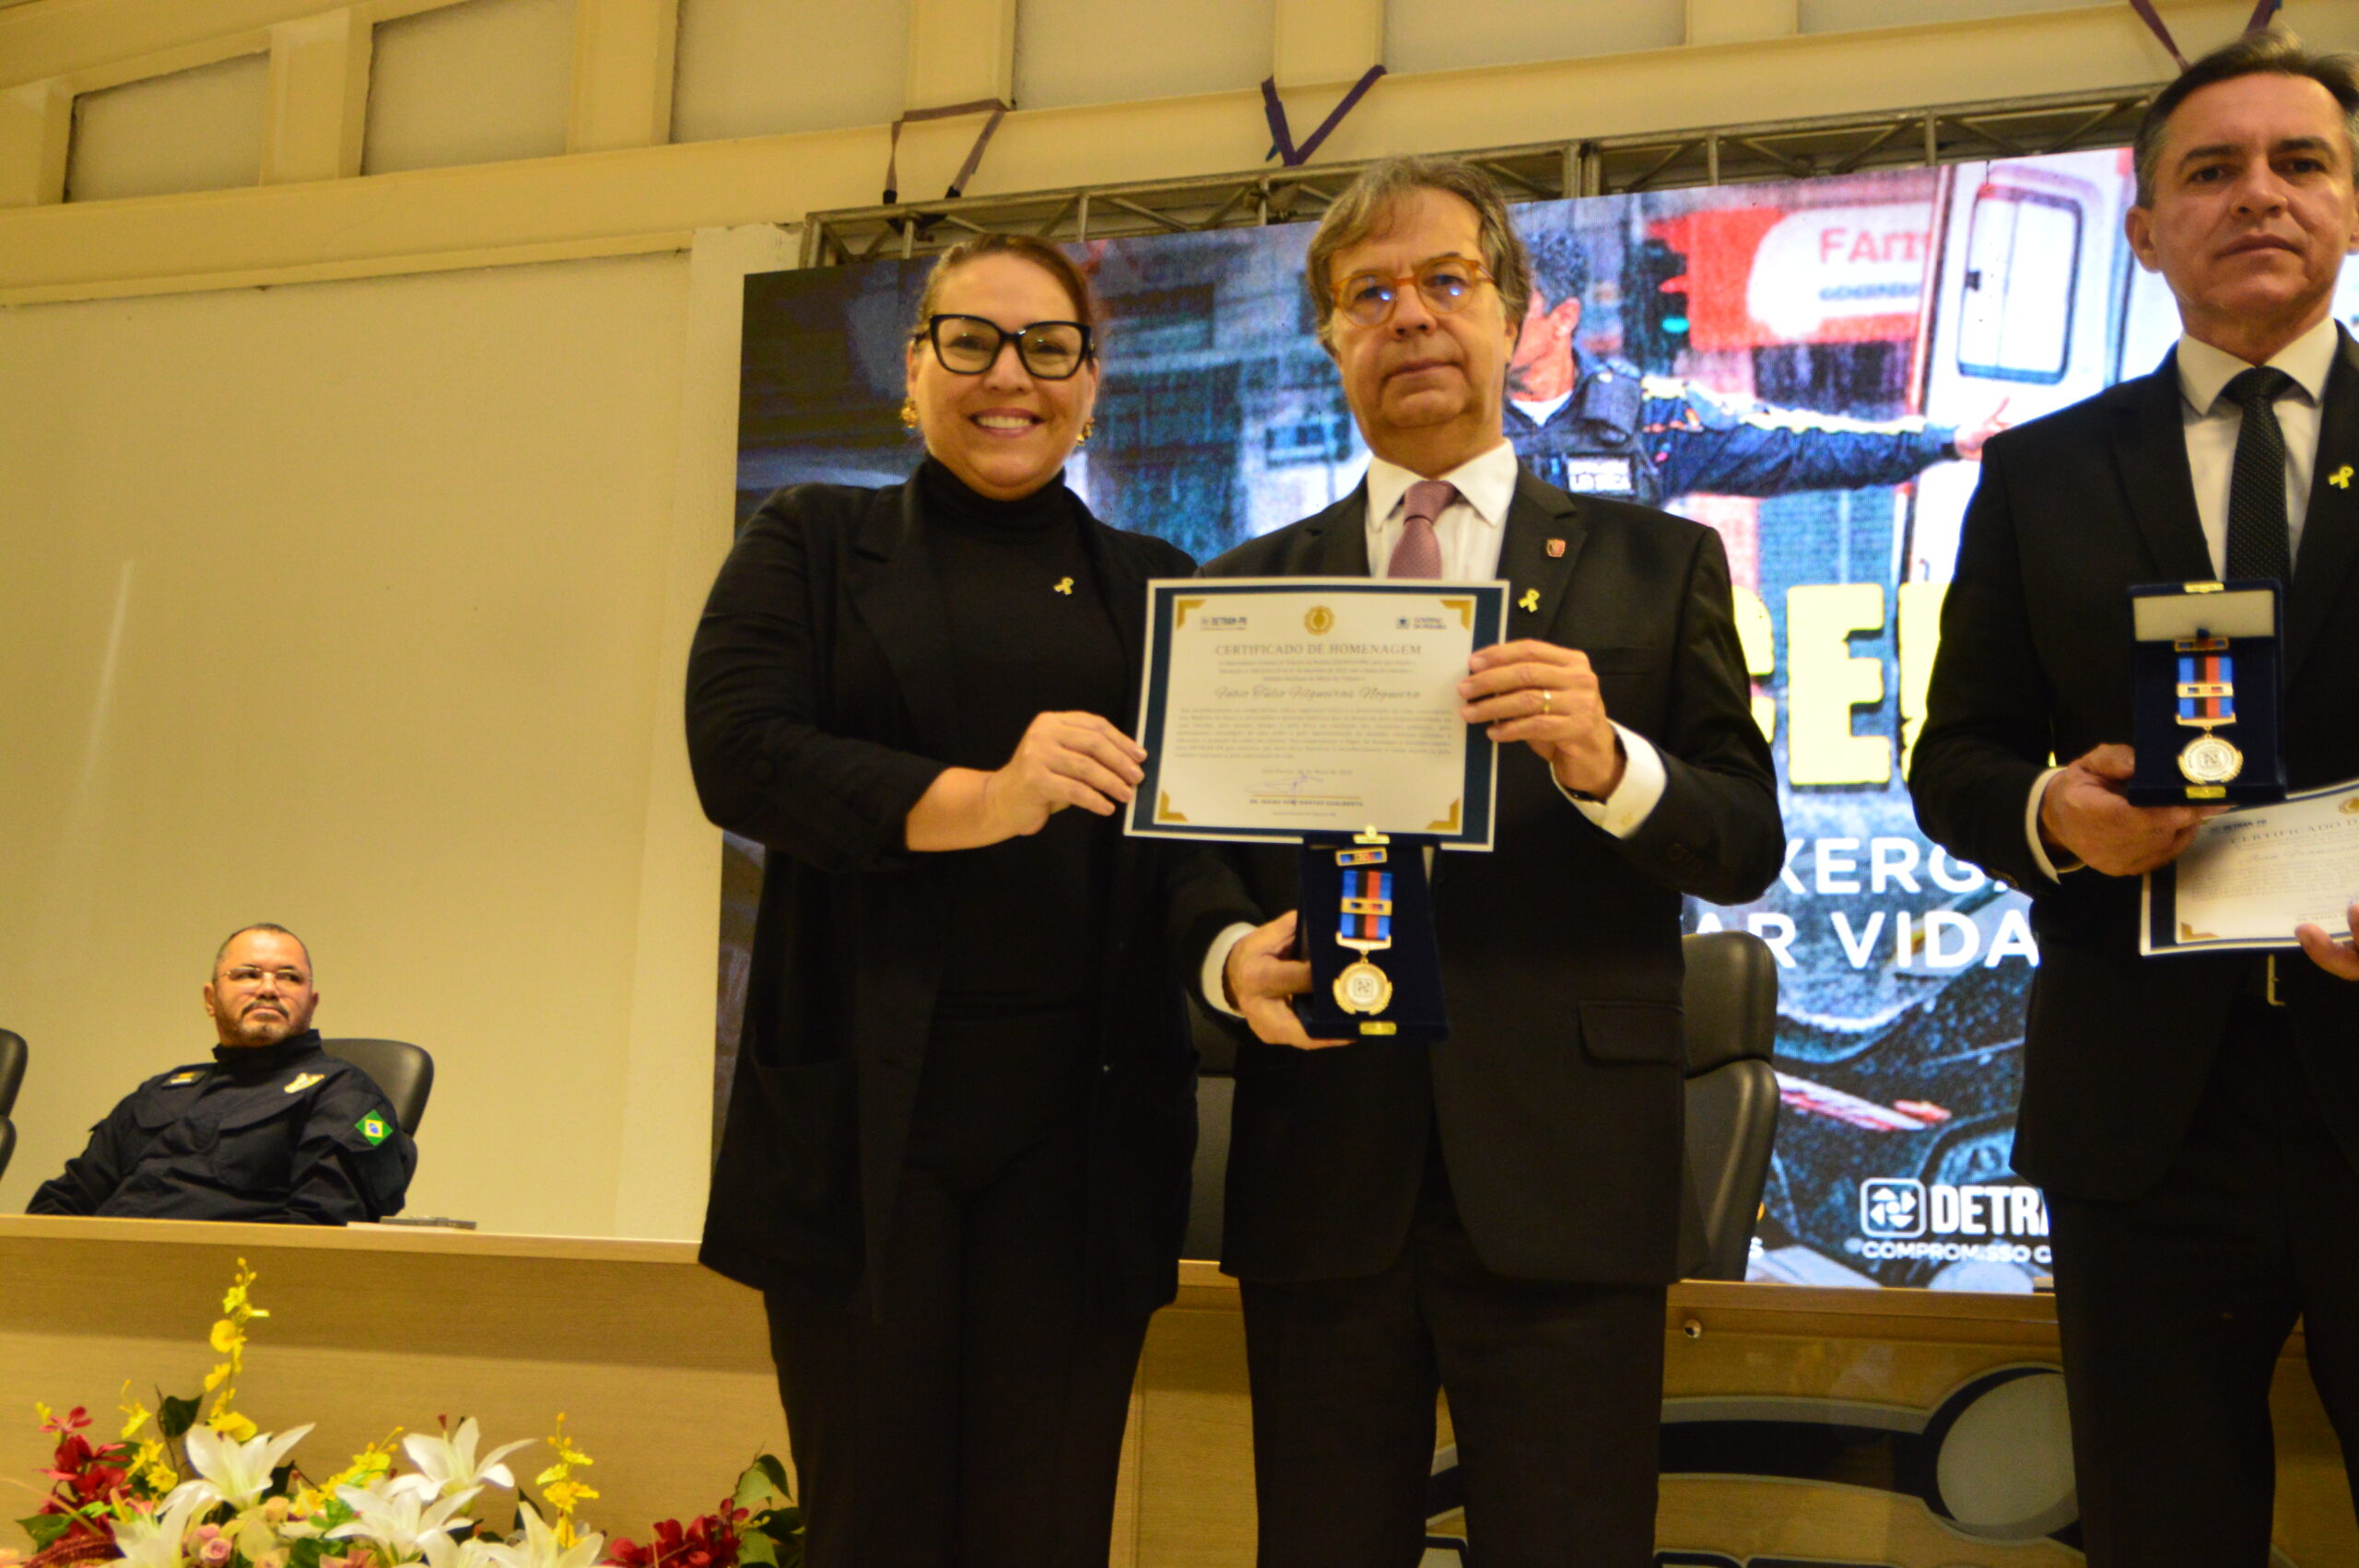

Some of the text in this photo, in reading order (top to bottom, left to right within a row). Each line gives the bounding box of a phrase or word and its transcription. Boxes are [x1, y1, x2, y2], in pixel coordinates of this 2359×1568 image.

[1215, 644, 1422, 656] CERTIFICADO DE HOMENAGEM
[1830, 908, 2040, 968] VIDA
[1931, 1186, 2049, 1236] DETR
[1862, 1241, 2031, 1262] COMPROMISSO
